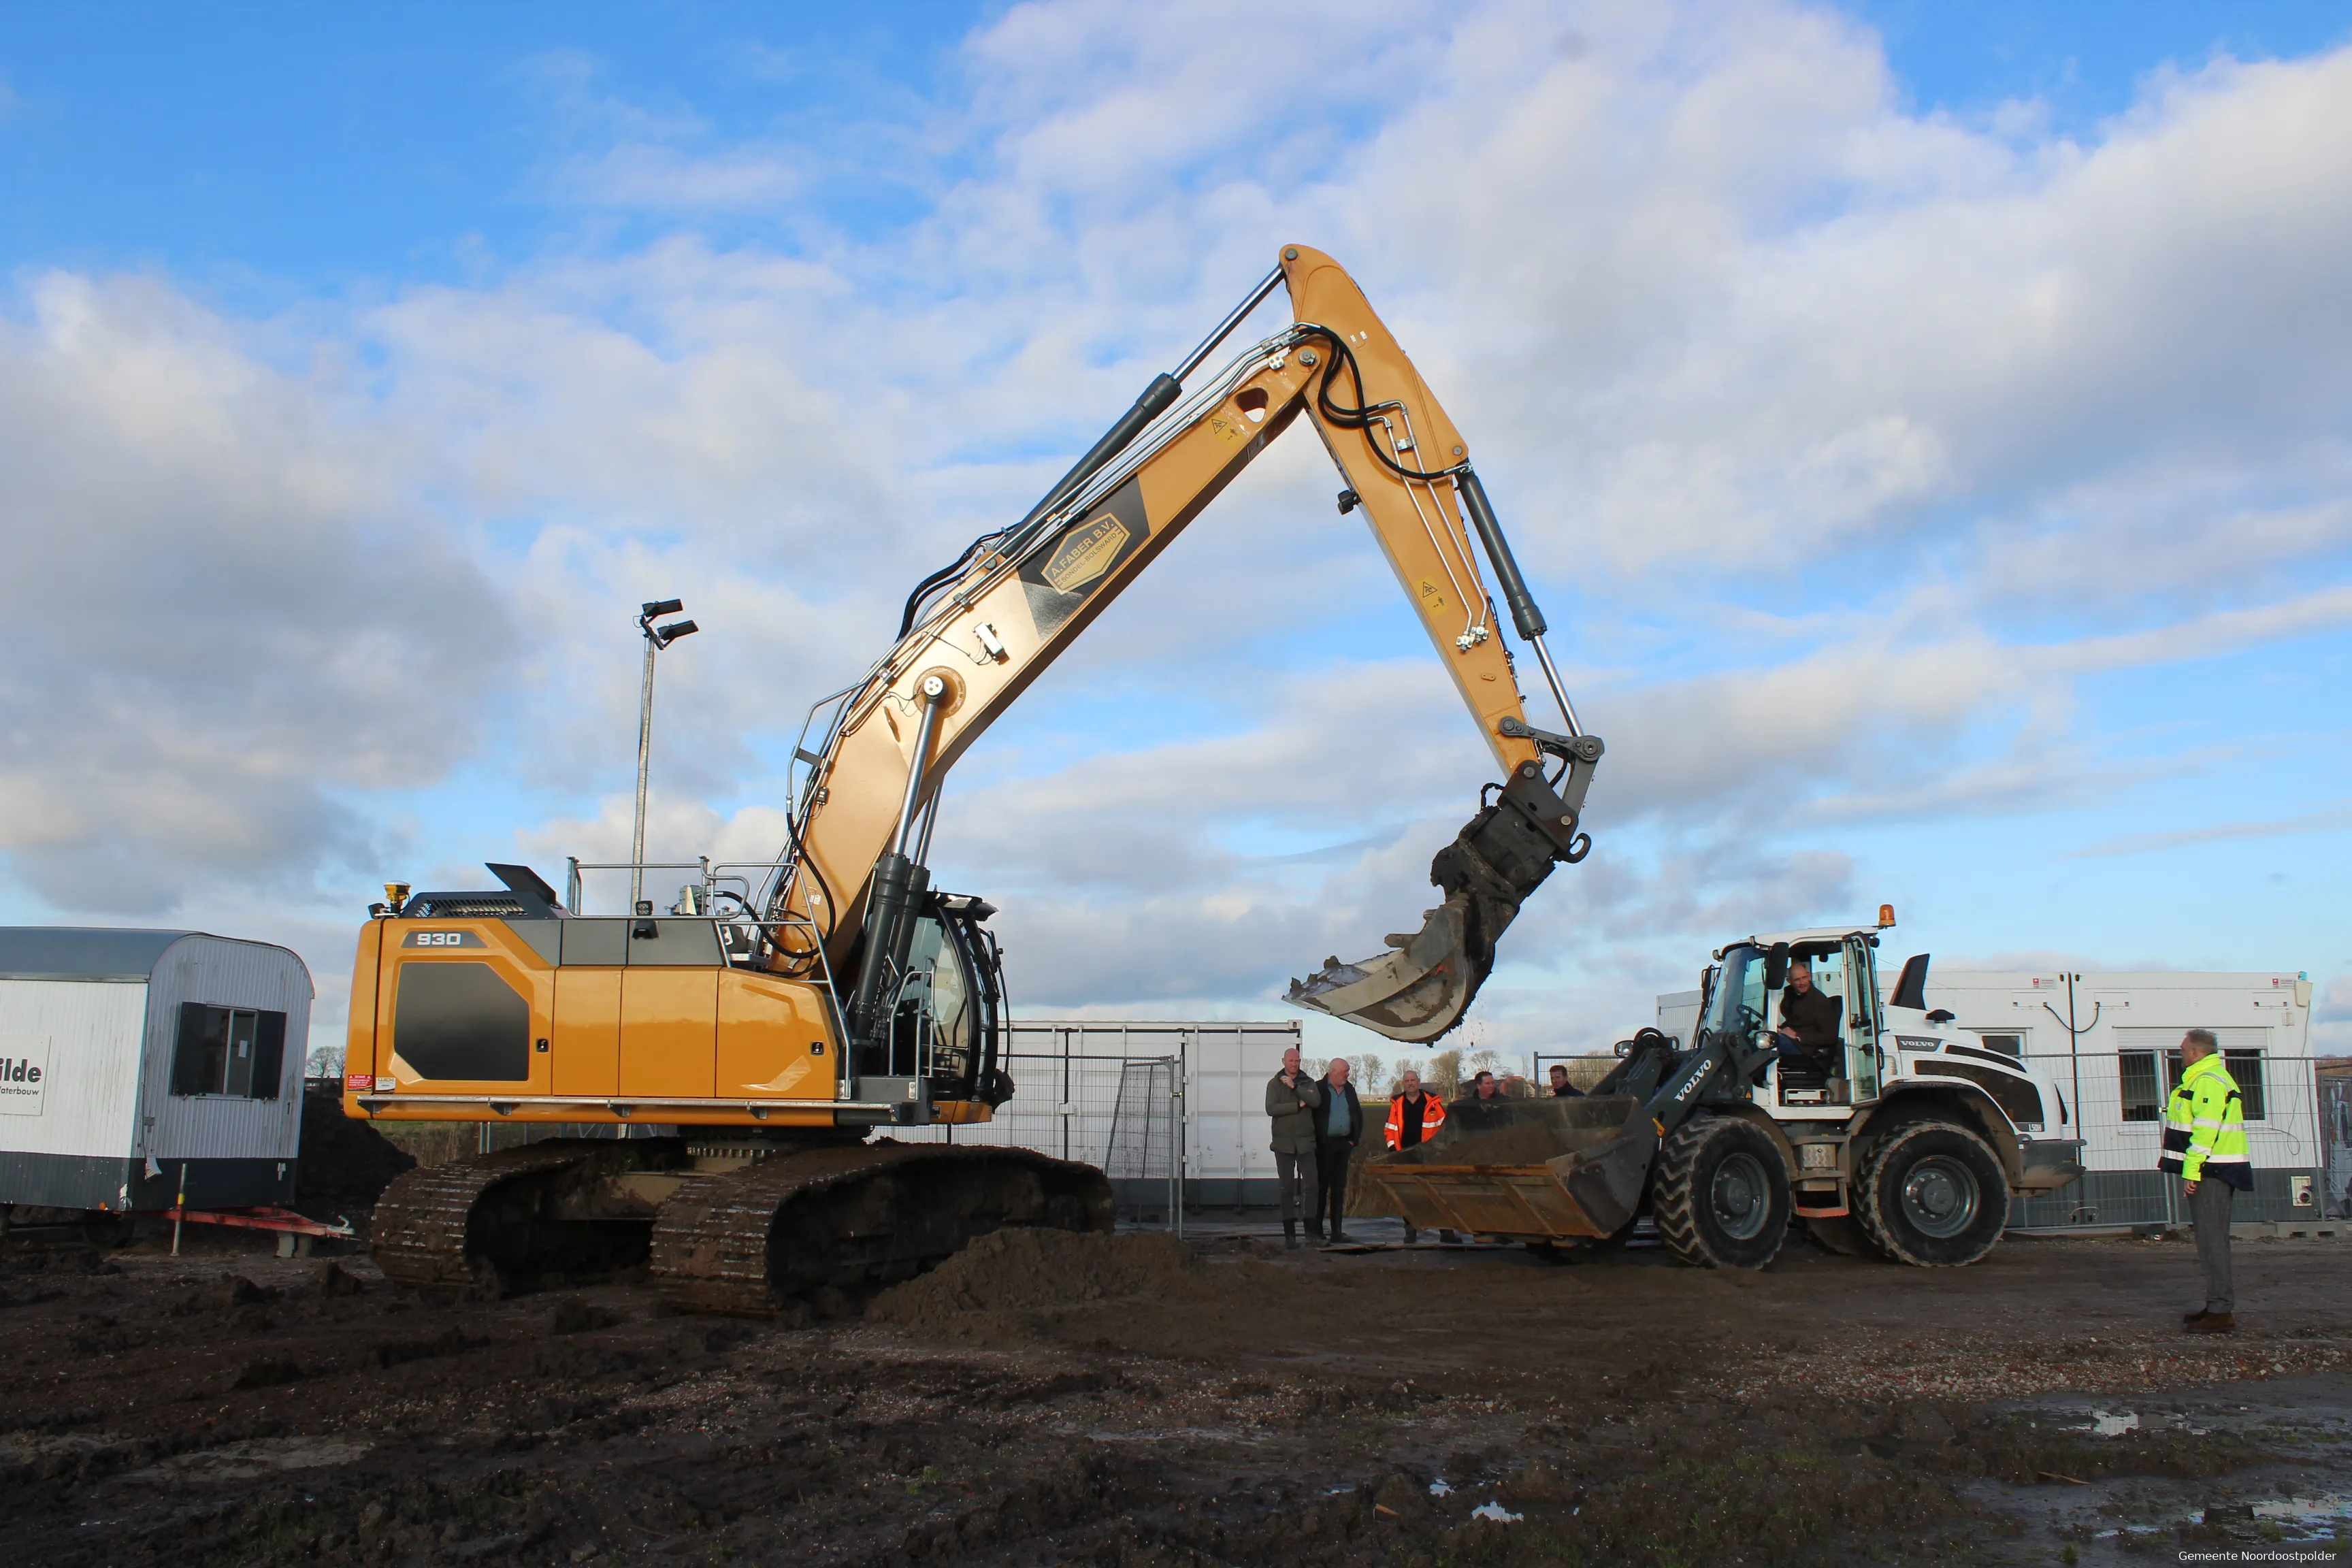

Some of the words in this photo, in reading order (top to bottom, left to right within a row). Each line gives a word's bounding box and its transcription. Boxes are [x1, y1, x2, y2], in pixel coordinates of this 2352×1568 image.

[1092, 521, 1114, 539] B.V.
[1061, 532, 1117, 583] SONDEL-BOLSWARD
[417, 933, 461, 945] 930
[1674, 1059, 1712, 1101] VOLVO
[0, 1086, 39, 1095] aterbouw
